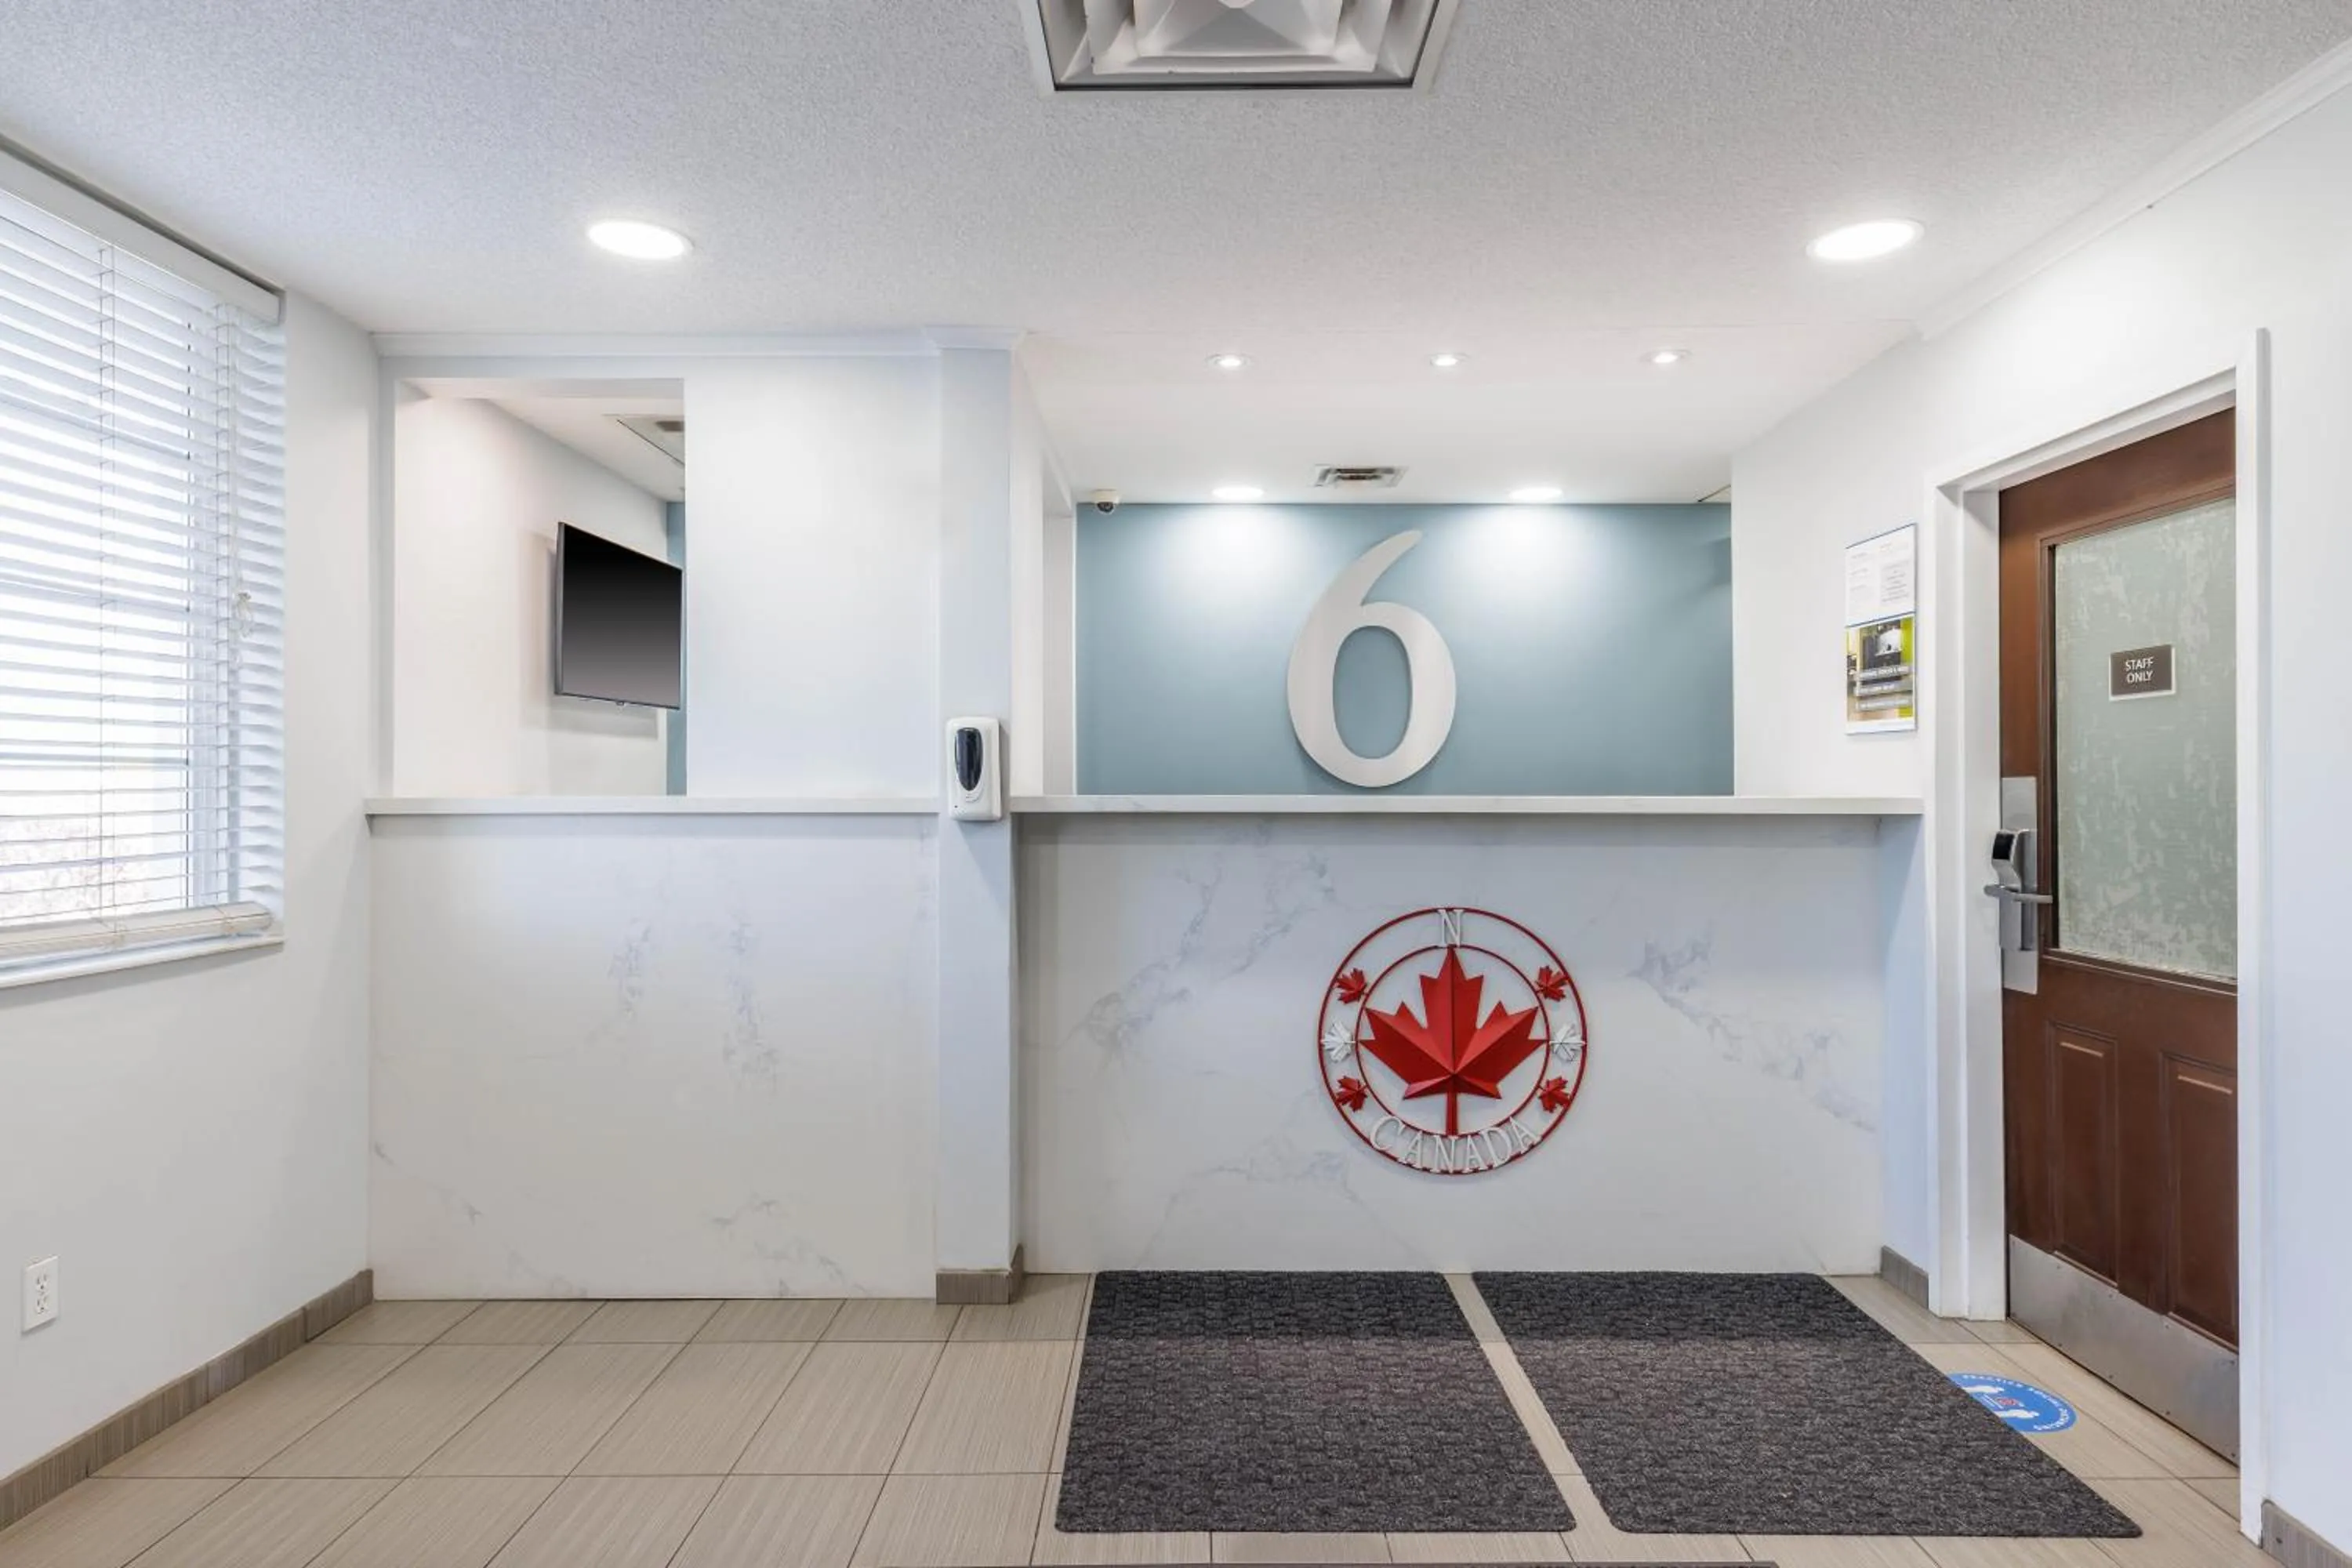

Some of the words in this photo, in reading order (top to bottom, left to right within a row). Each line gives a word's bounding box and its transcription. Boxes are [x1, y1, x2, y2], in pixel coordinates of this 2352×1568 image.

[1287, 529, 1456, 788] 6
[2125, 656, 2154, 672] STAFF
[2126, 670, 2153, 684] ONLY
[1438, 909, 1465, 948] N
[1370, 1116, 1542, 1173] CANADA
